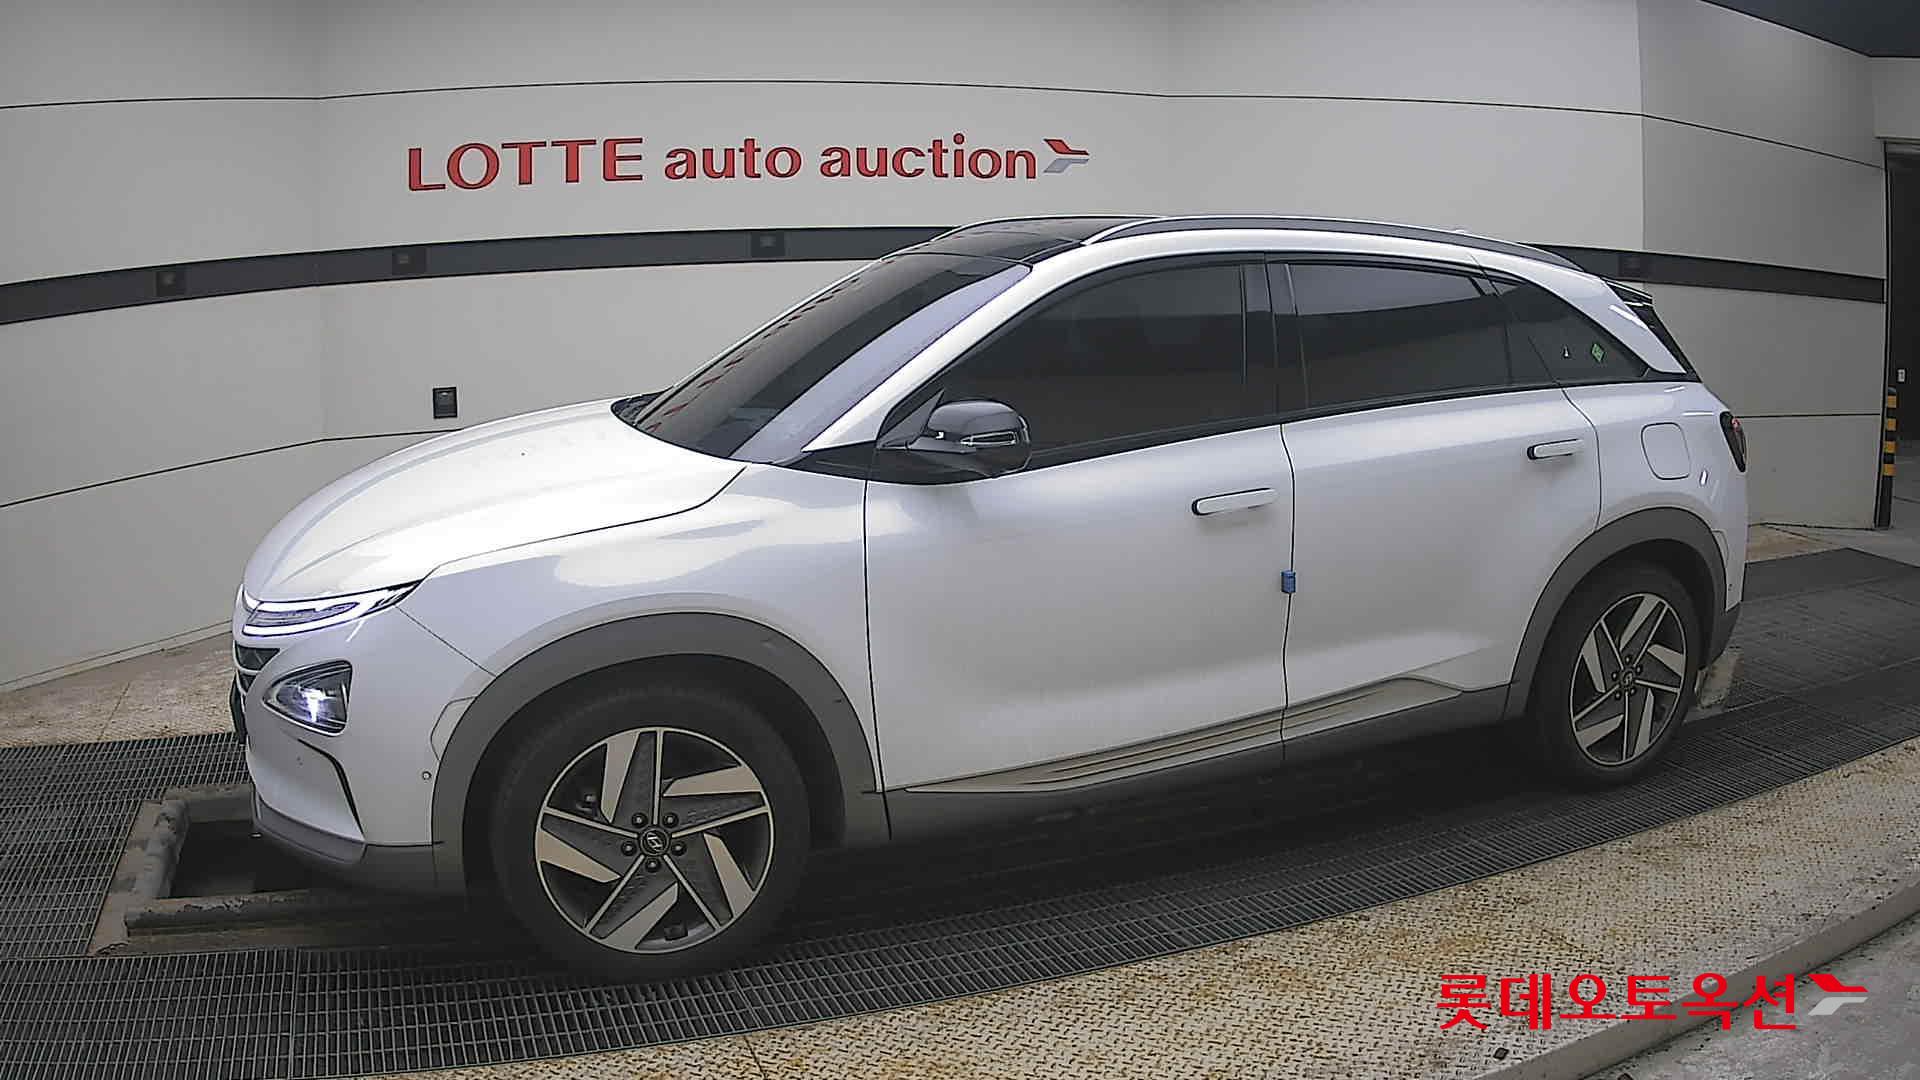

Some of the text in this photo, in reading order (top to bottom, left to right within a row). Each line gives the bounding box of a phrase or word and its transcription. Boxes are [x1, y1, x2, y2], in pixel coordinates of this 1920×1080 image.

[408, 133, 1038, 192] LOTTE auto auction
